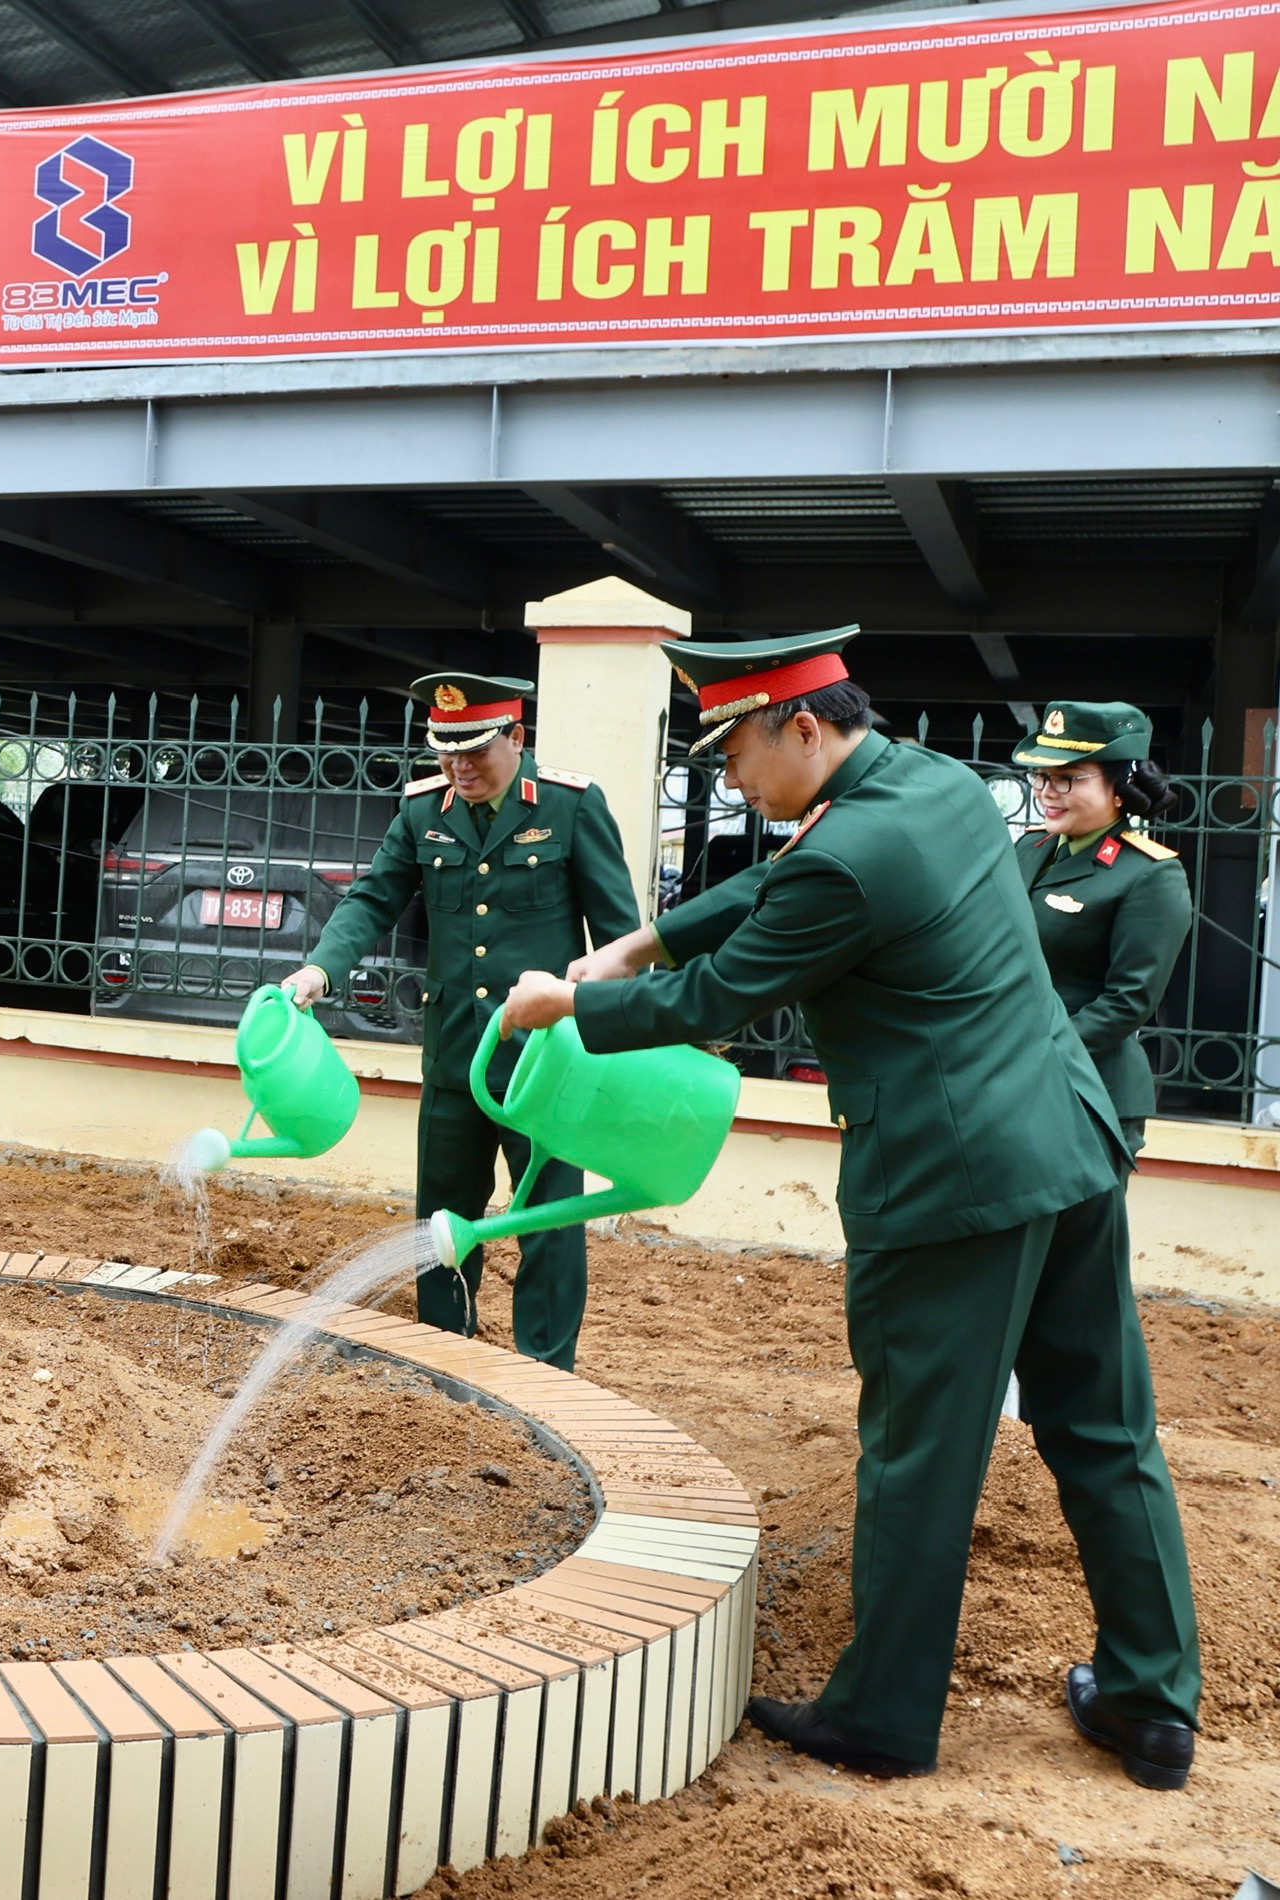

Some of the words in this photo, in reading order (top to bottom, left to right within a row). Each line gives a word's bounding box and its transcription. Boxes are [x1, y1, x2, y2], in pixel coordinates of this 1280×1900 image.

[283, 113, 368, 206] VÌ
[401, 107, 553, 212] LỢI
[589, 90, 767, 187] ÍCH
[807, 50, 1117, 172] MƯỜI
[21, 313, 43, 330] Giá
[119, 308, 158, 328] Mạnh
[235, 223, 319, 316] VÌ
[351, 220, 500, 324] LỢI
[536, 205, 712, 300] ÍCH
[748, 182, 1079, 292] TRĂM
